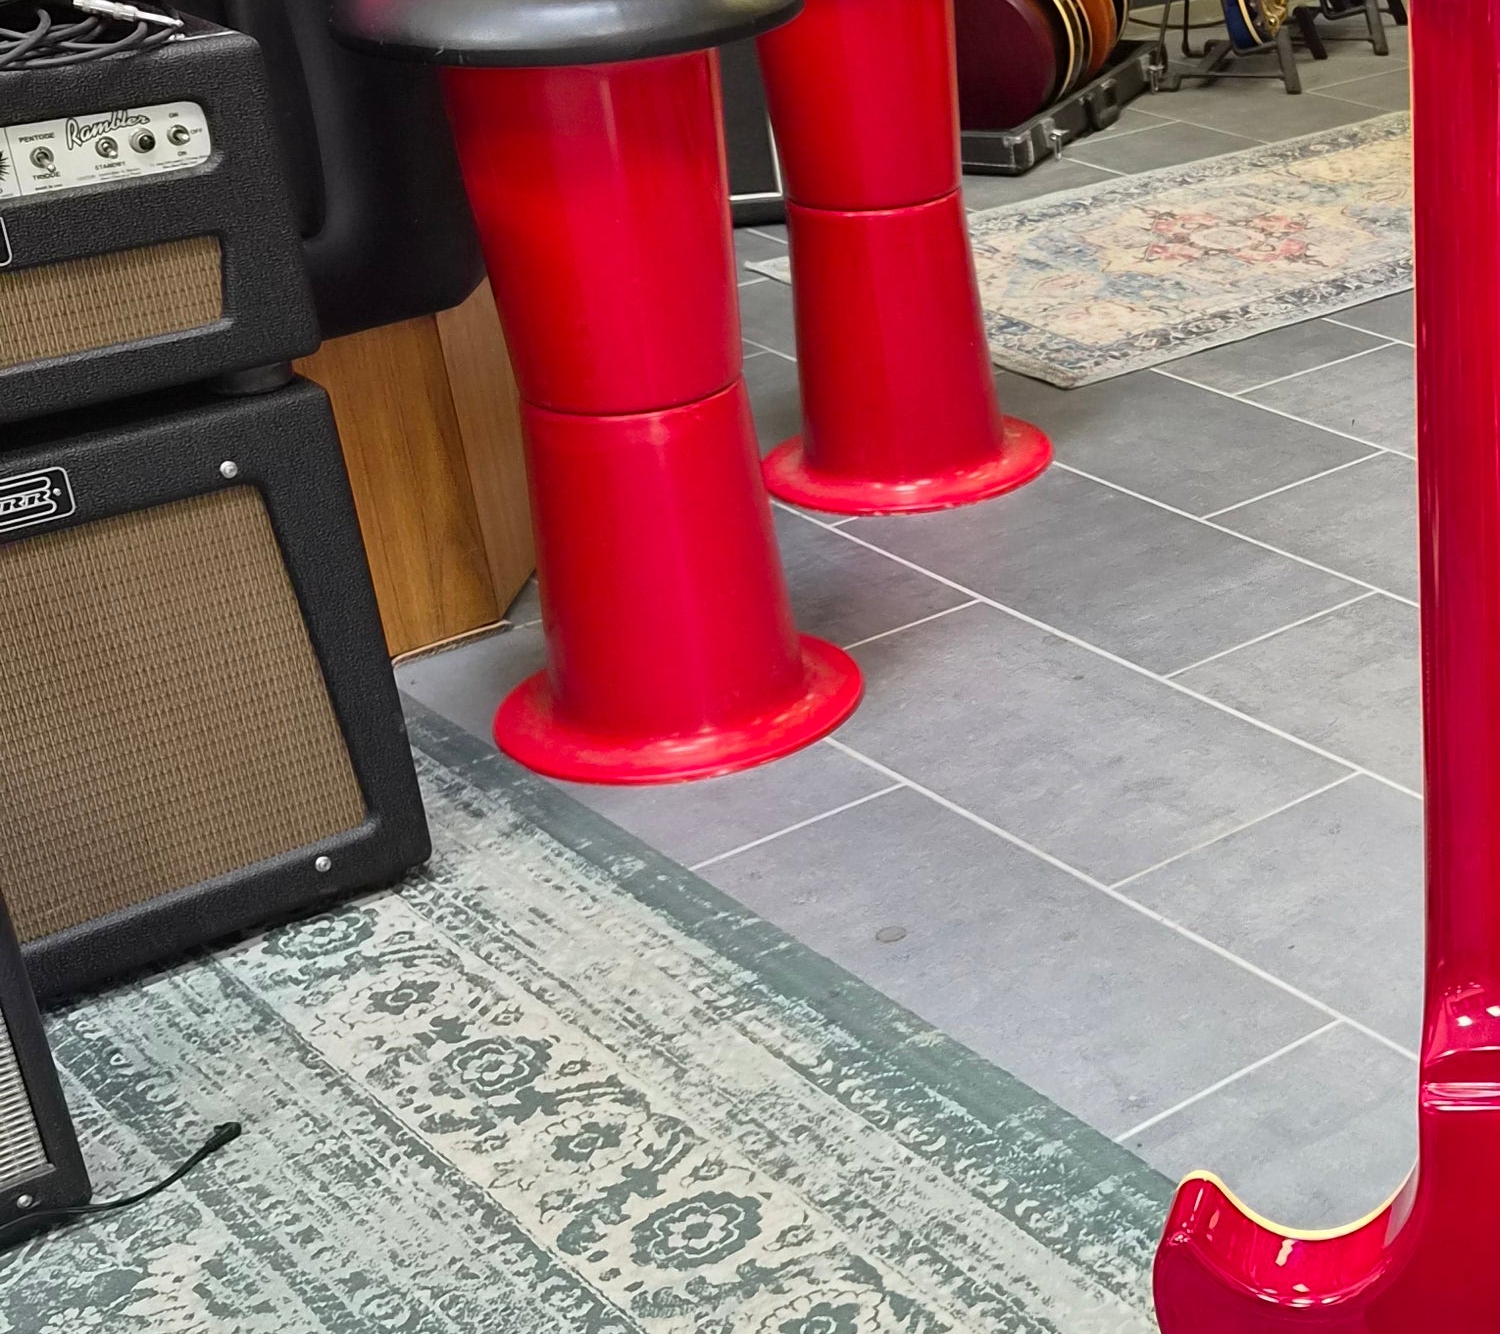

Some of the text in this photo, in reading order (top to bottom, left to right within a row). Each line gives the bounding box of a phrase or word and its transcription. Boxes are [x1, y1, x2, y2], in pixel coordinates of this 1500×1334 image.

[65, 110, 151, 151] Rambler
[18, 132, 55, 143] PENTODE
[32, 171, 61, 180] TRIODE
